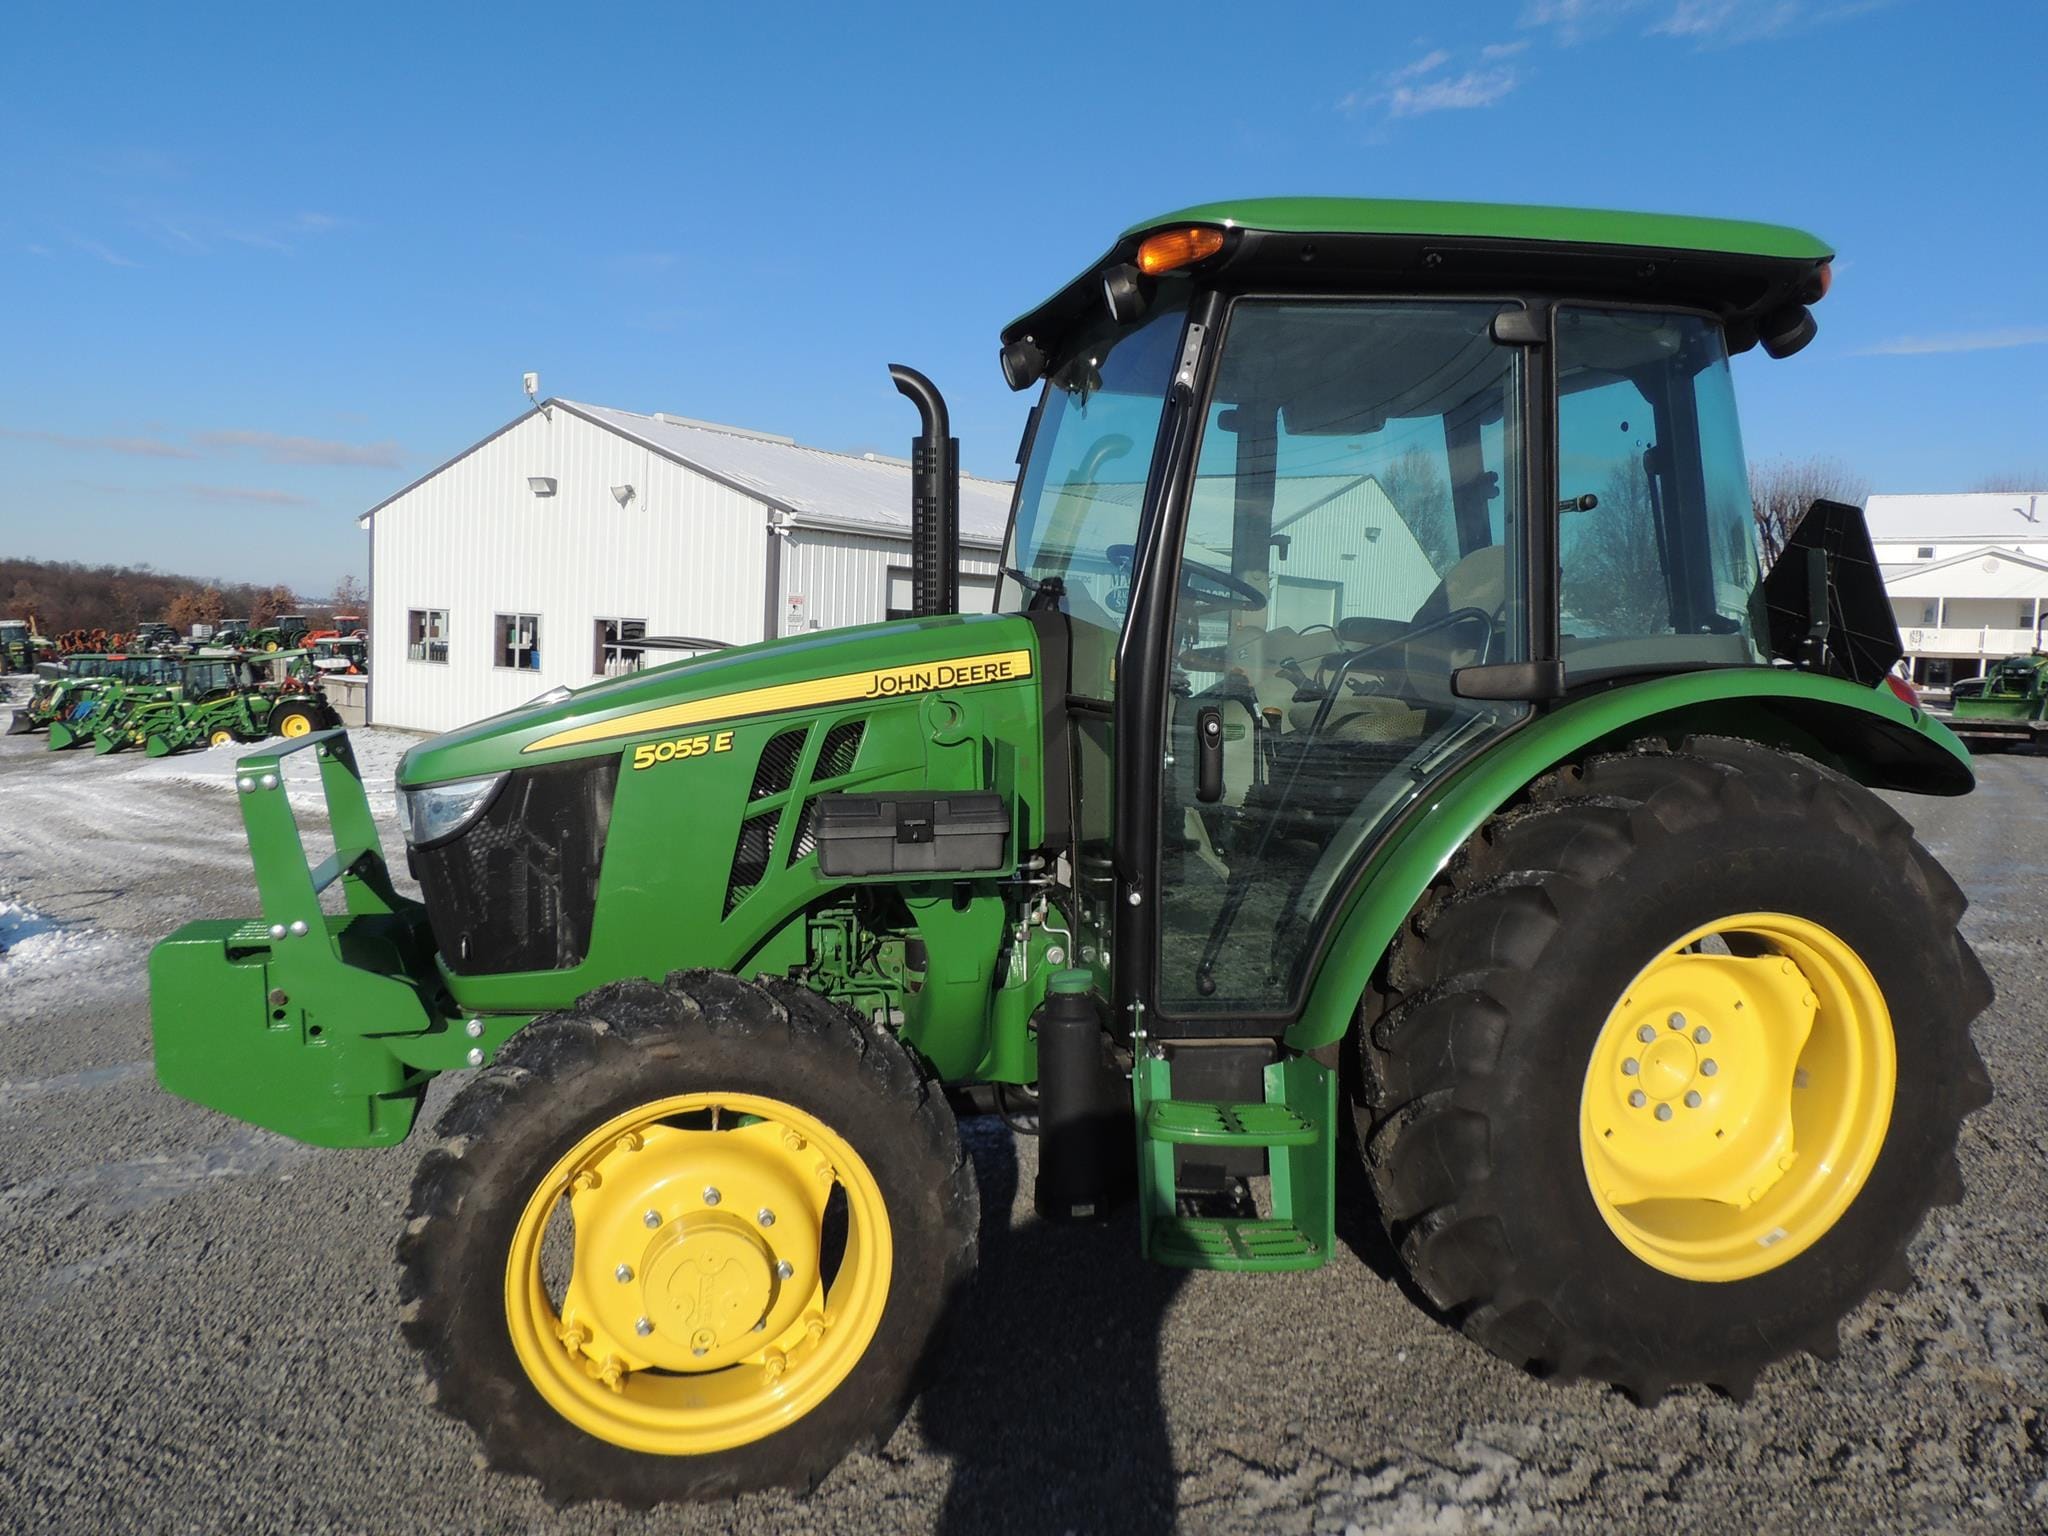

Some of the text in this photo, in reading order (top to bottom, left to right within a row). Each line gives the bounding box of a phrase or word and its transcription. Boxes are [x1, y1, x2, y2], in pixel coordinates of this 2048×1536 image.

[866, 661, 1013, 696] JOHN DEERE
[633, 731, 735, 770] 5055 E
